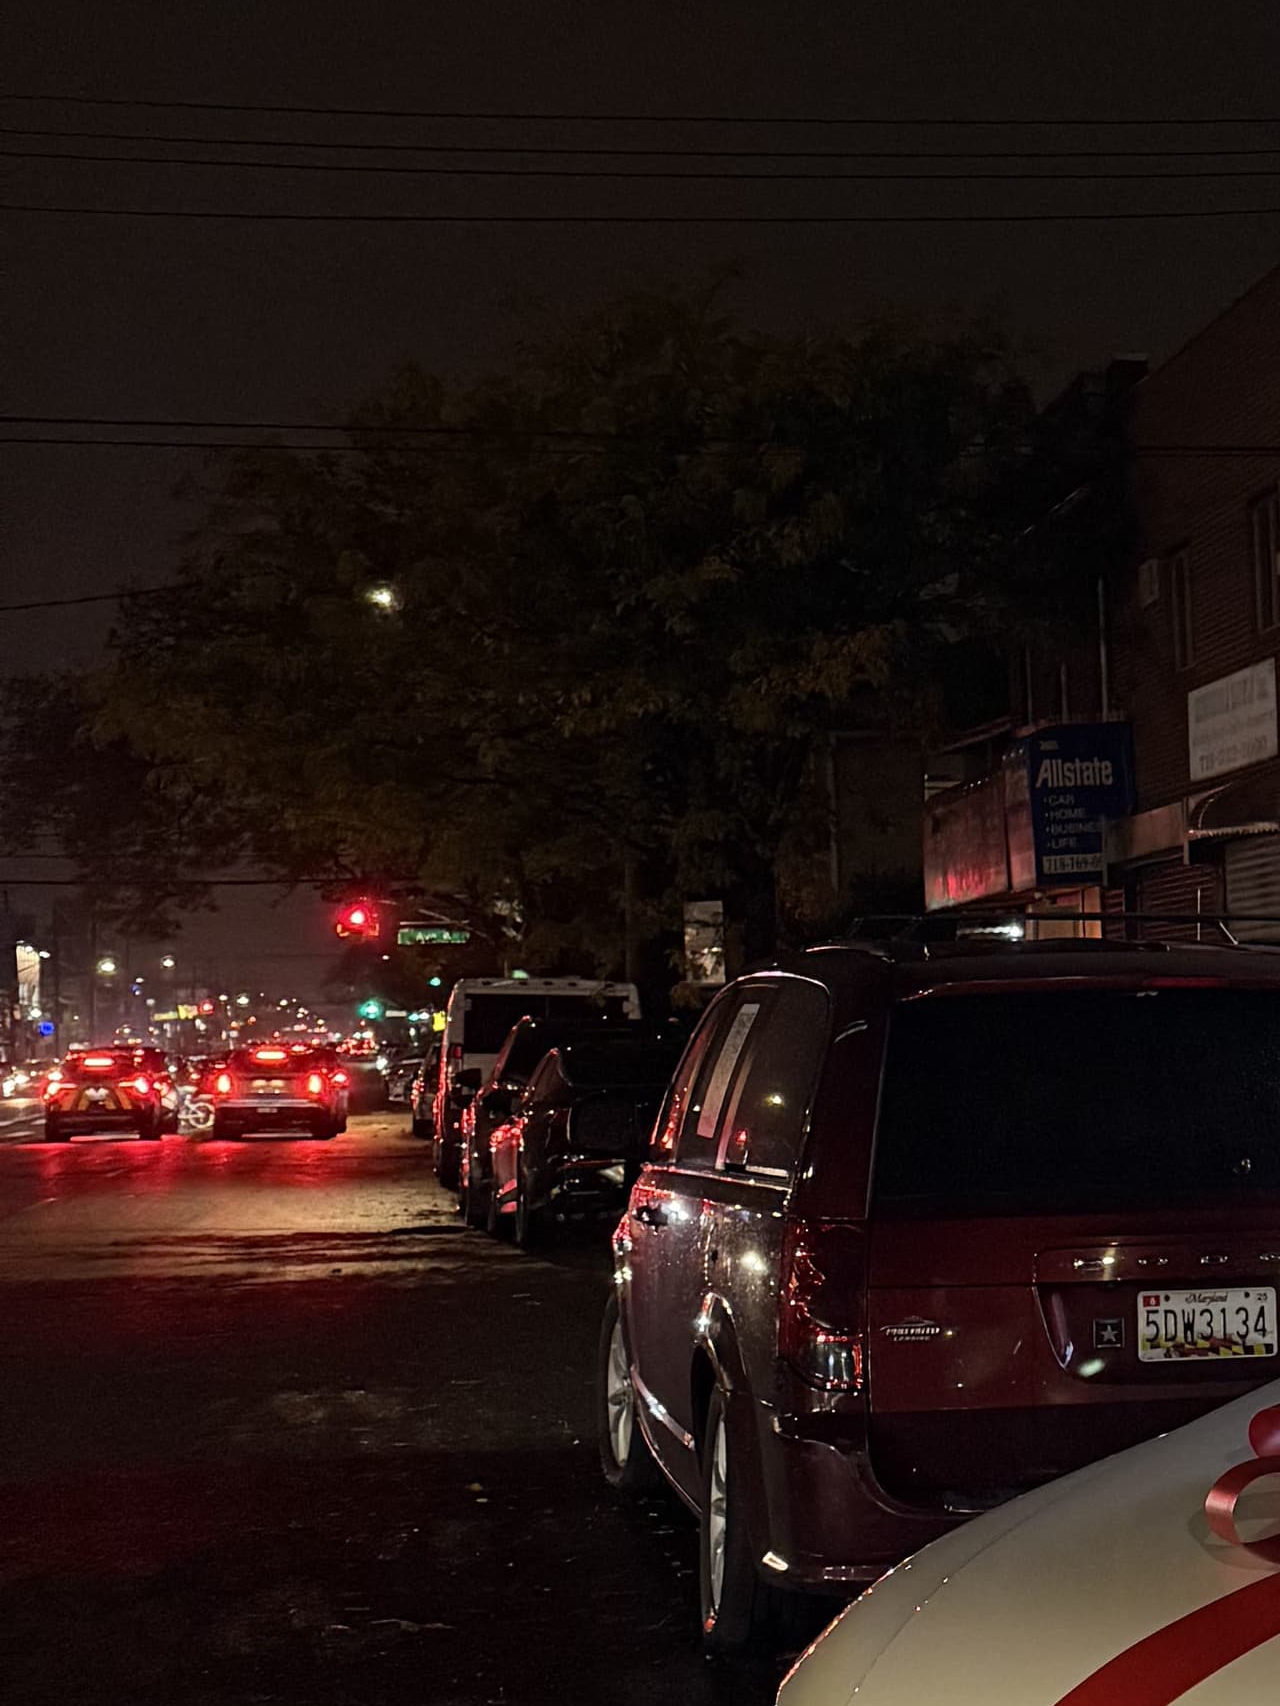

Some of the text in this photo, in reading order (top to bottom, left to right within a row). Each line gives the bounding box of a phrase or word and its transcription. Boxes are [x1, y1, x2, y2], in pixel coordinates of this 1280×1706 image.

[1035, 757, 1113, 789] Allstate
[1185, 1293, 1228, 1305] Maryland
[1146, 1305, 1267, 1346] 5DW3134
